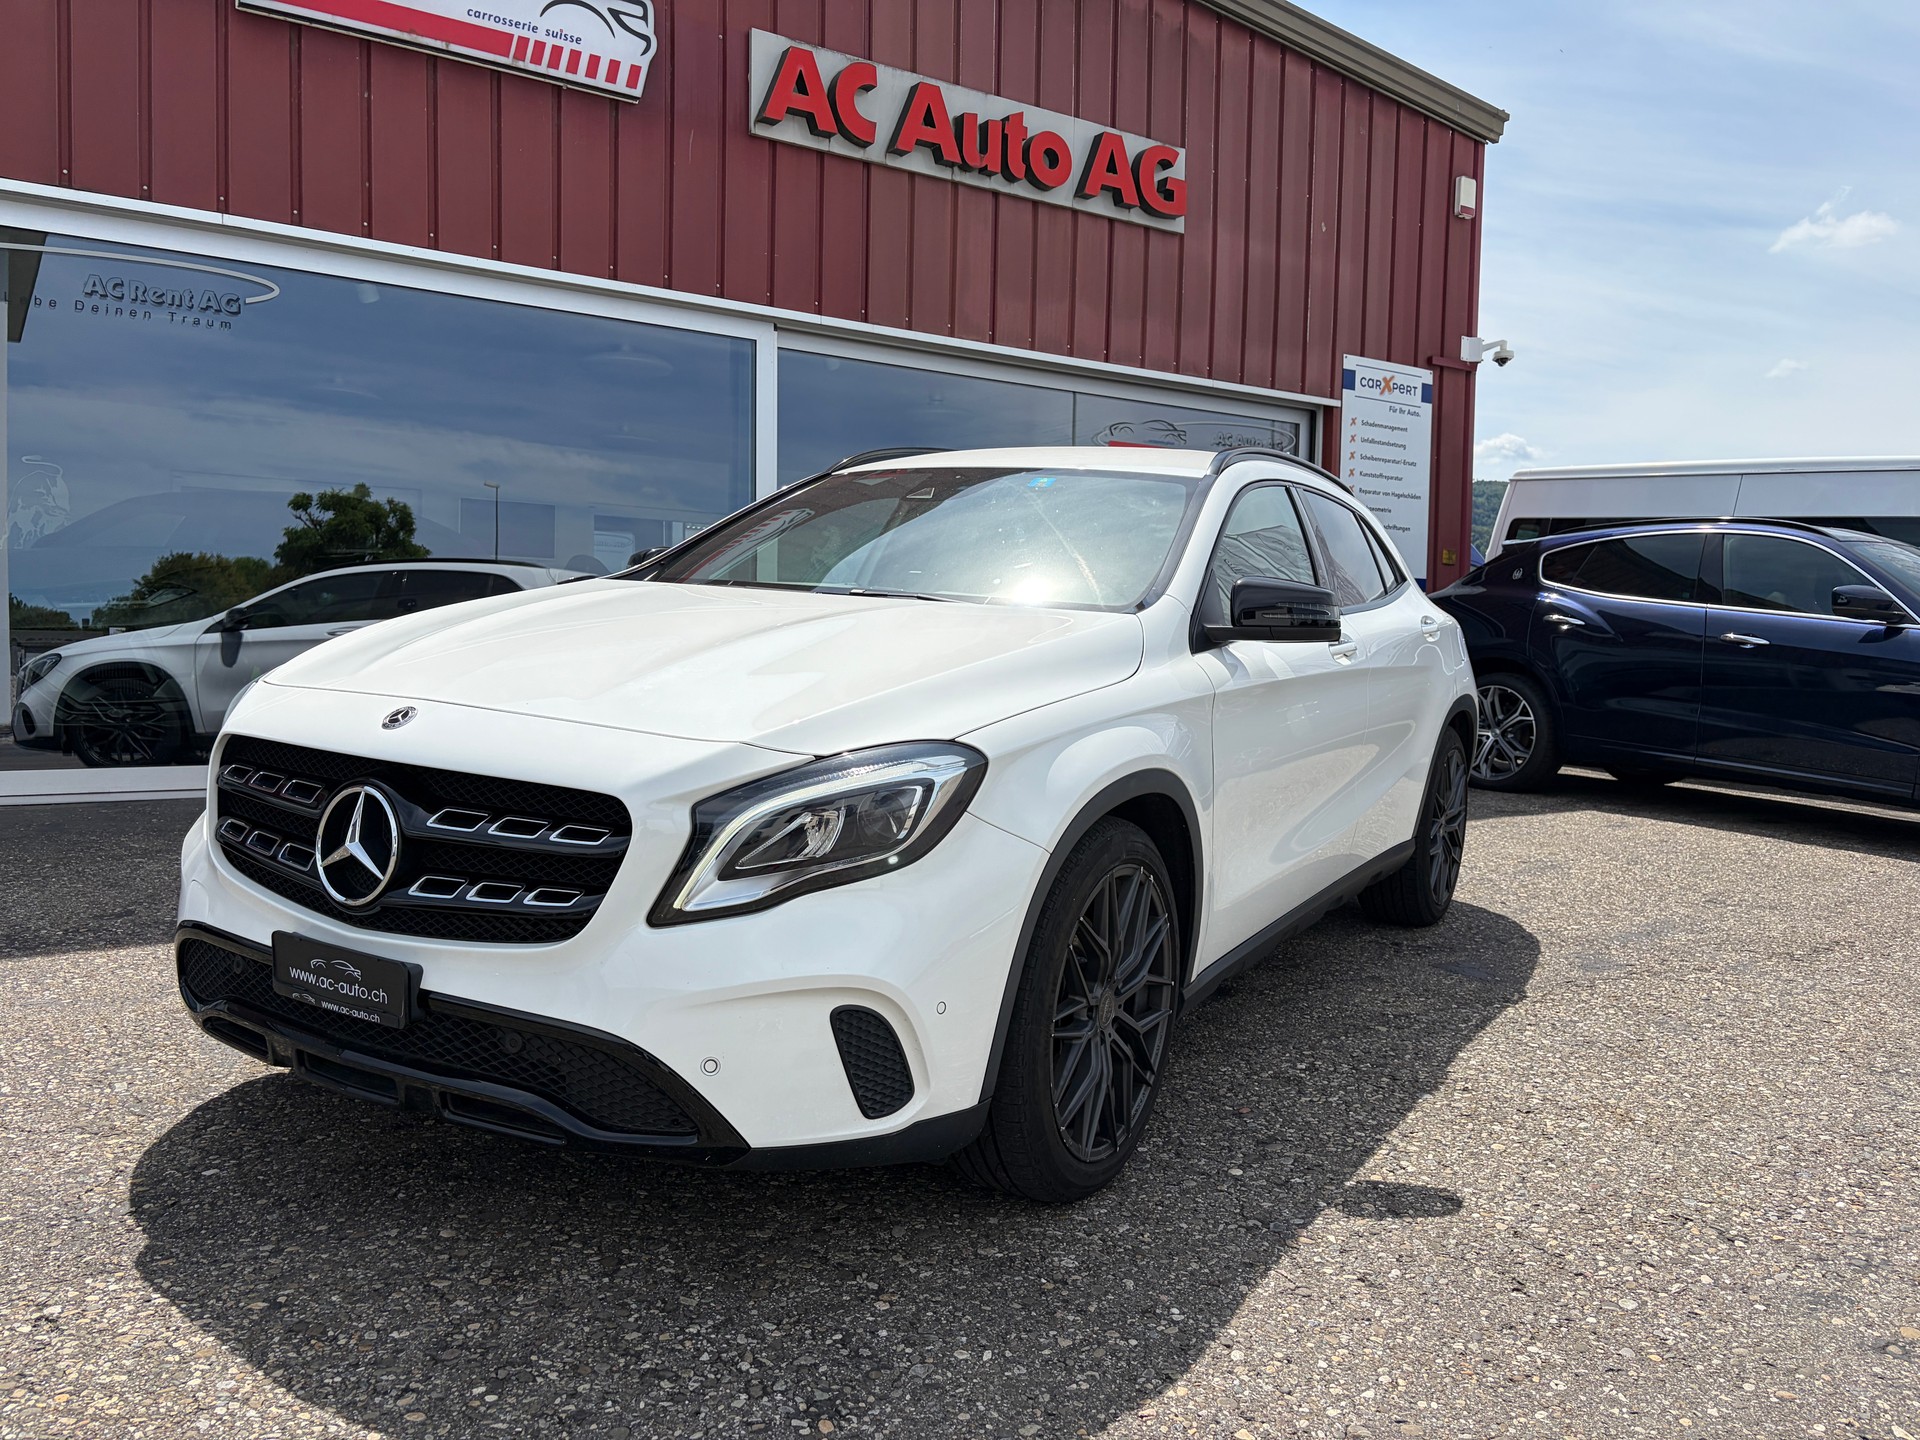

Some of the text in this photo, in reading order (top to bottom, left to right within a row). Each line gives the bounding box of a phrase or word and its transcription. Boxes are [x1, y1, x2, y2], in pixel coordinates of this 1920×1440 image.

[467, 6, 582, 45] carrosserie suisse
[756, 45, 1187, 219] AC Auto AG
[82, 274, 242, 316] AC Rent AG
[75, 299, 152, 321] Deinen
[168, 310, 232, 331] Traum
[1389, 405, 1398, 414] Für
[1398, 407, 1406, 415] Ihr
[1361, 419, 1408, 433] Schadenmanagement
[1360, 436, 1407, 450] Unfallinstandsetzung
[1359, 470, 1403, 481] Kunststoffreparatur
[1358, 487, 1381, 496] Reparatur
[289, 966, 388, 1005] www.ac-auto.ch
[321, 1000, 381, 1024] www.ac-auto.ch
